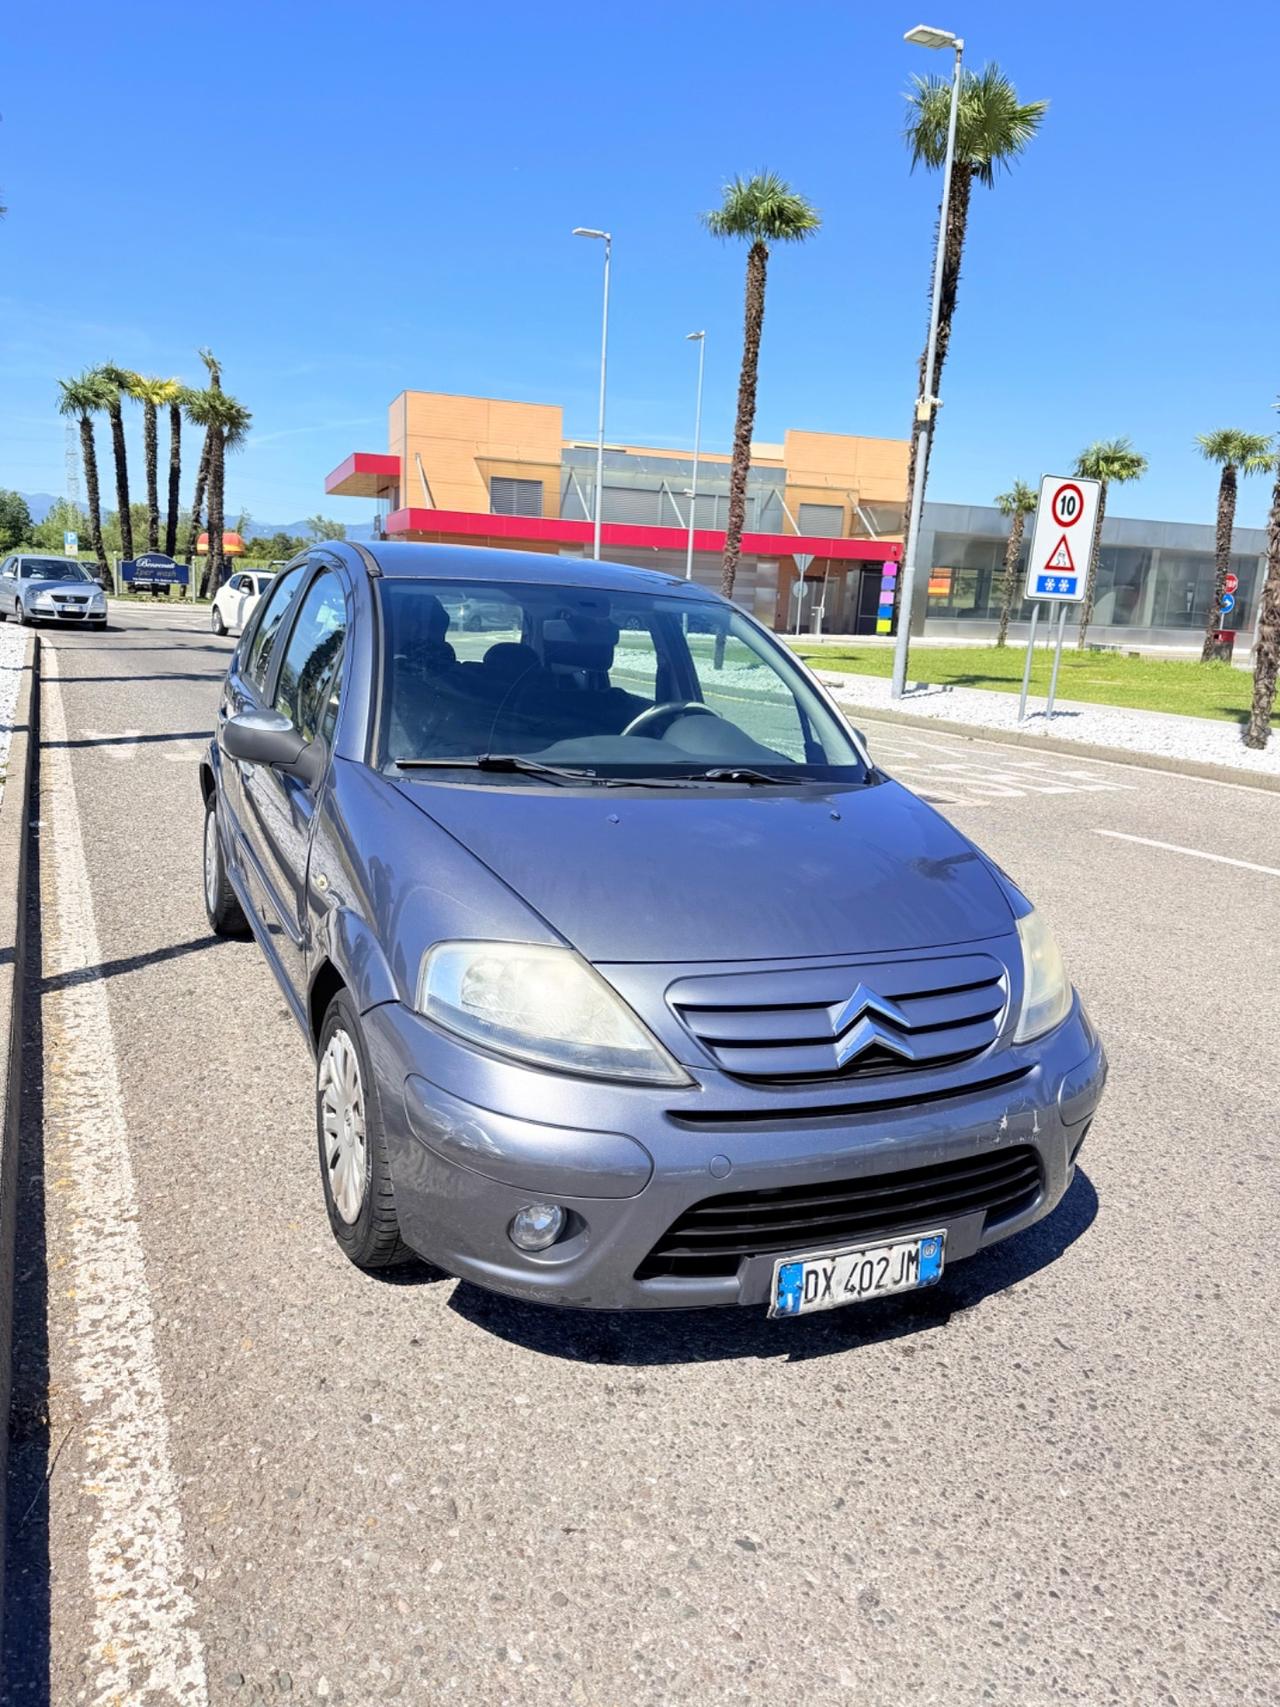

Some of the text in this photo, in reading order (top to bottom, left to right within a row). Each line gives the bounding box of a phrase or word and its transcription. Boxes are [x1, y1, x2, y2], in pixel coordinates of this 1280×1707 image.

[1060, 495, 1076, 516] 10
[67, 532, 76, 544] P
[804, 1266, 836, 1304] DX
